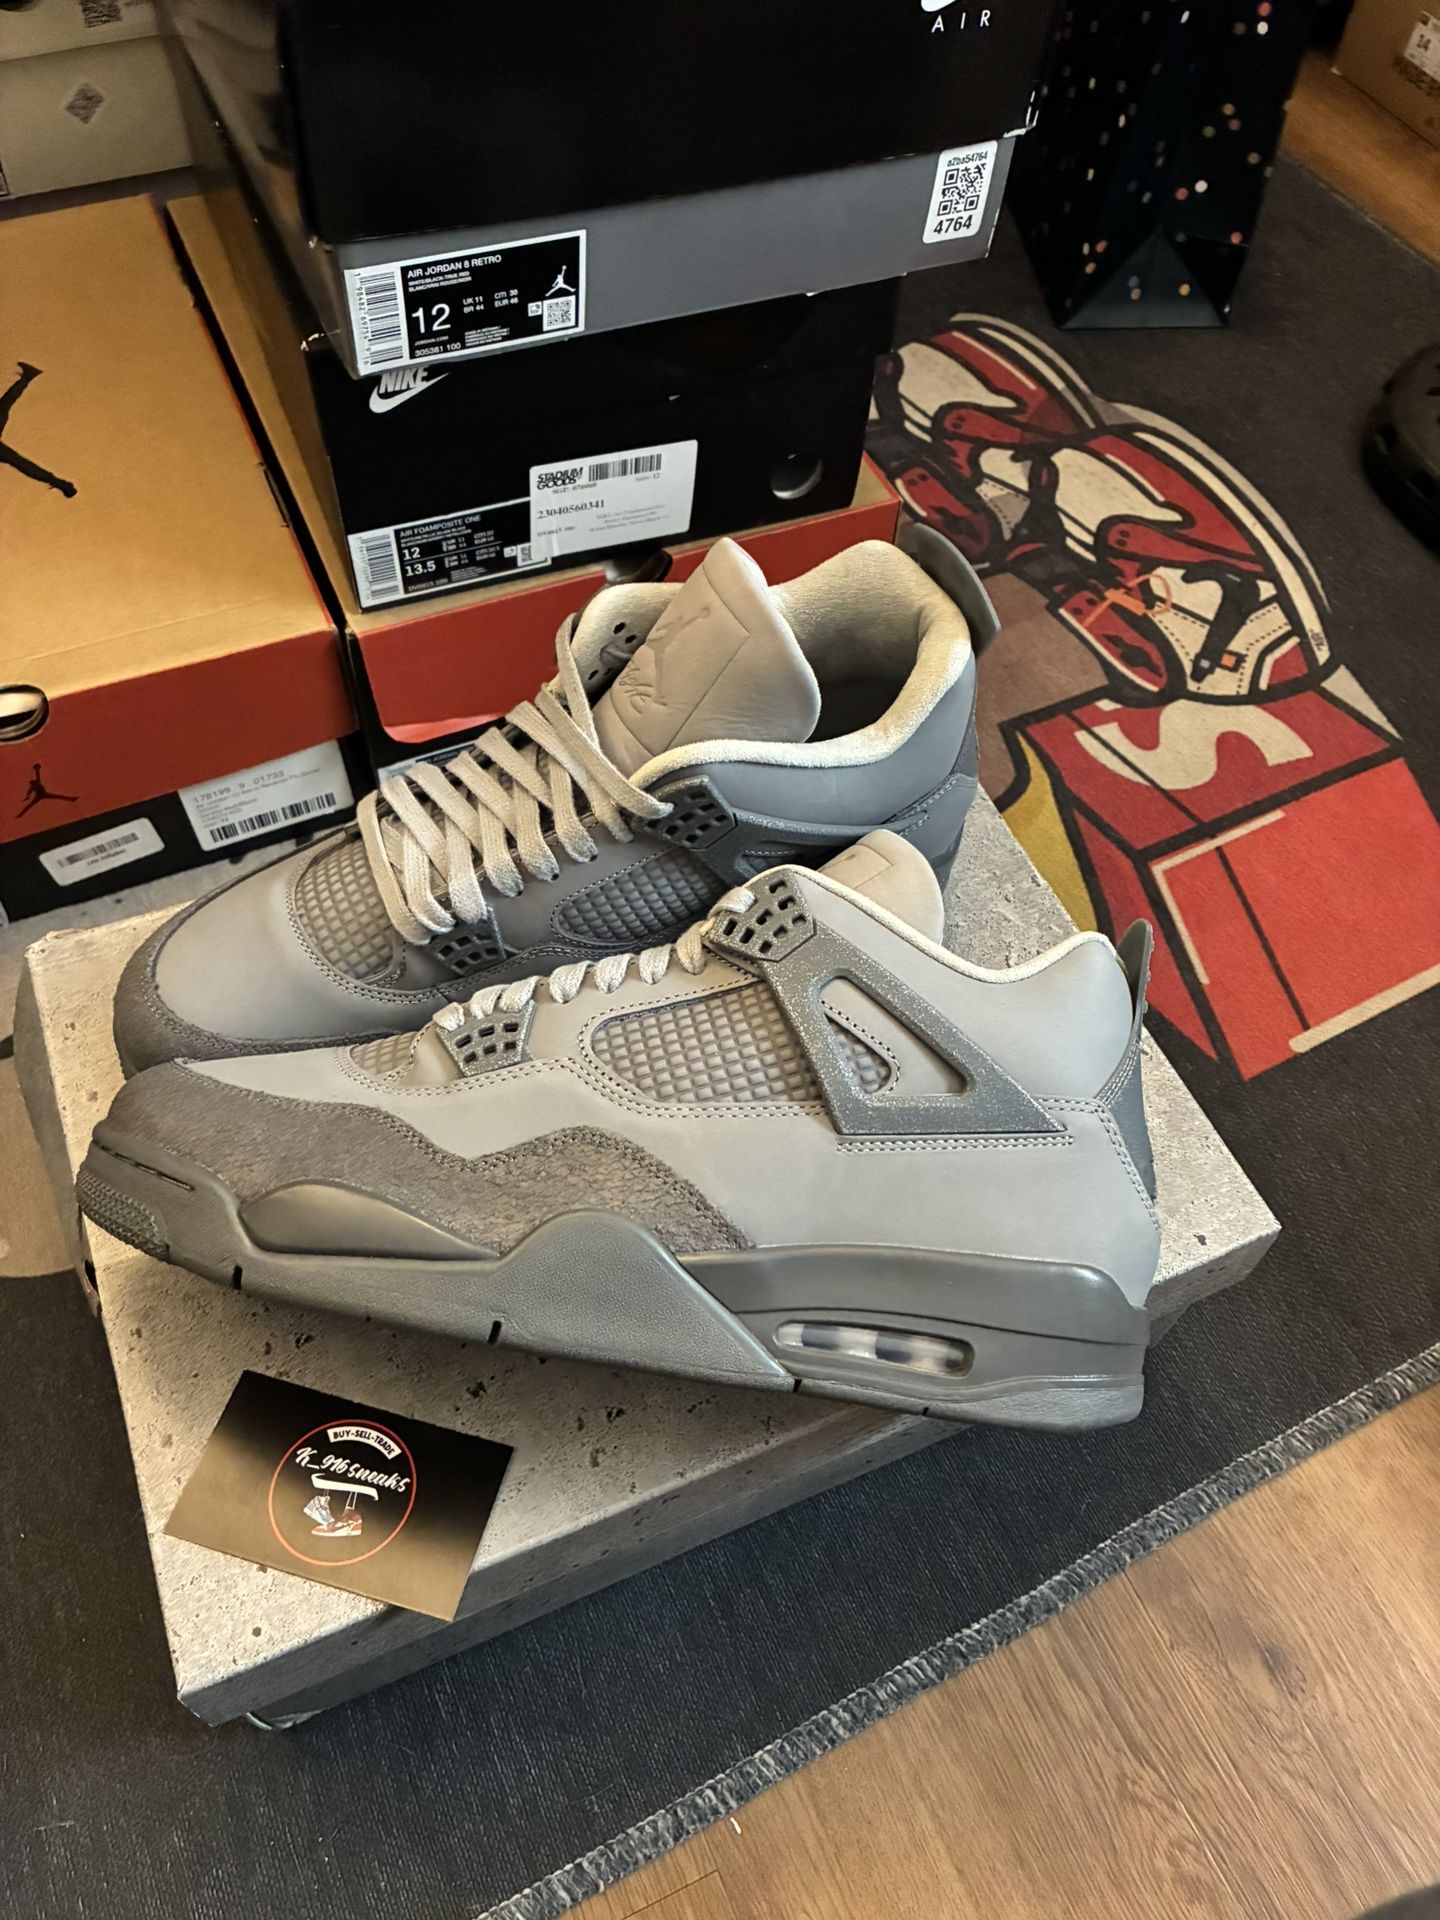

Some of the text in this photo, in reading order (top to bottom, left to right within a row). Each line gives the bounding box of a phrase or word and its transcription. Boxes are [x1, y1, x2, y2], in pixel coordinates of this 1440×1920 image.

[931, 10, 991, 33] AIR
[933, 214, 973, 235] 4764
[407, 255, 502, 279] AIR JORDAN 8 RETRO
[463, 297, 474, 306] UK
[475, 295, 483, 303] 11
[463, 305, 474, 314] BR
[494, 299, 509, 308] EUR
[411, 303, 451, 334] 12
[414, 342, 461, 358] 305381 100
[378, 366, 428, 393] NIKE
[537, 466, 584, 481] STADIUM
[537, 478, 576, 490] GOODS
[537, 500, 604, 519] 23040560341
[400, 529, 413, 538] AIR
[414, 519, 463, 535] FOAMPOSITE
[464, 514, 481, 524] ONE
[402, 547, 420, 560] 12
[404, 560, 436, 577] 13.5
[333, 1429, 395, 1456] BUY-SELL-TRADE
